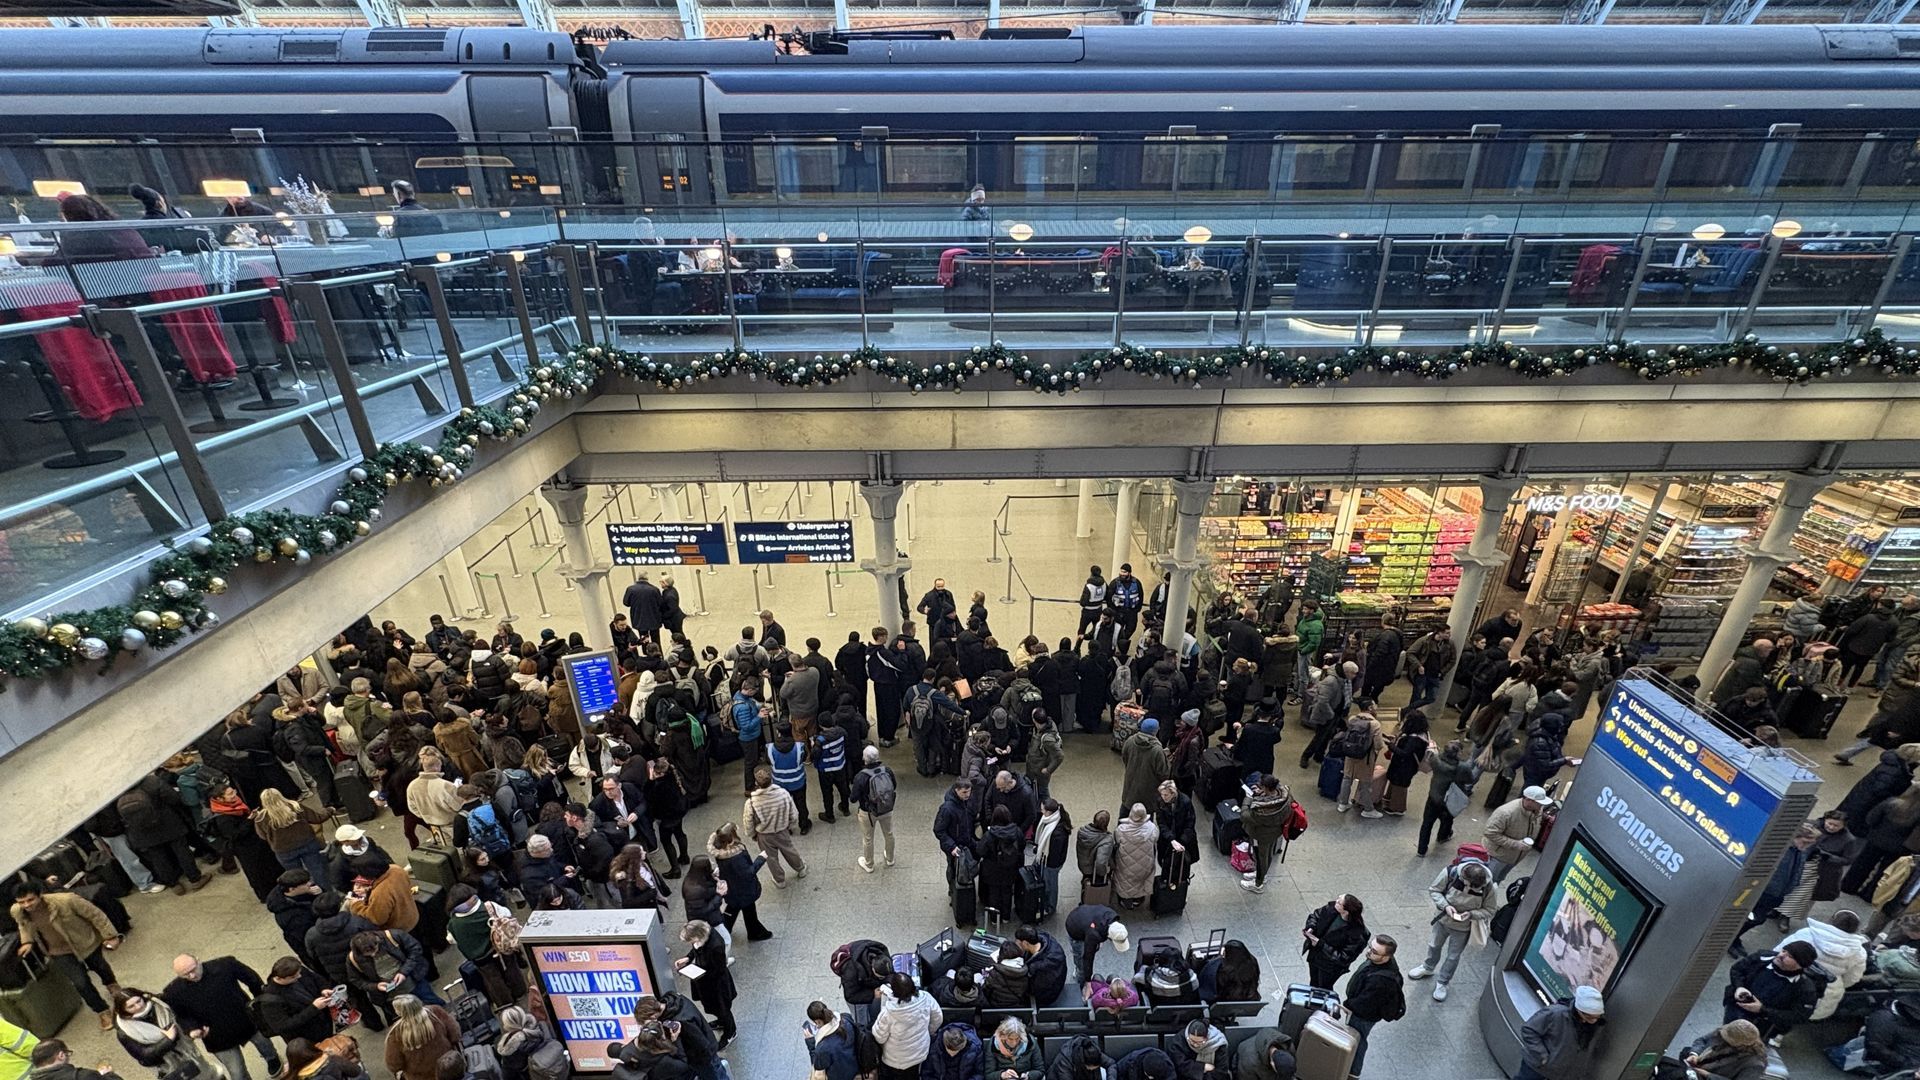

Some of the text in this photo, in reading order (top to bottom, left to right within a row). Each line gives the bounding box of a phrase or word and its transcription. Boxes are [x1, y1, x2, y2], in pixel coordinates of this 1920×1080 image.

[1527, 495, 1622, 511] M&S FOOD
[656, 524, 682, 532] Départs
[797, 522, 838, 530] Underground
[1628, 699, 1684, 744] Underground
[1616, 728, 1634, 748] Way
[1633, 744, 1648, 758] out
[1622, 715, 1655, 744] Arrivals
[1654, 739, 1692, 772] Arrivées
[1695, 810, 1730, 844] Toilets
[1627, 839, 1672, 880] INTERNATIONAL
[1568, 866, 1607, 910] gesture with
[1573, 852, 1616, 900] Make a grand
[1562, 876, 1617, 940] Festive Fizz Offers
[543, 951, 567, 962] WIN
[568, 951, 591, 962] £50
[547, 972, 636, 992] HOW WAS
[564, 1021, 617, 1039] VISIT?
